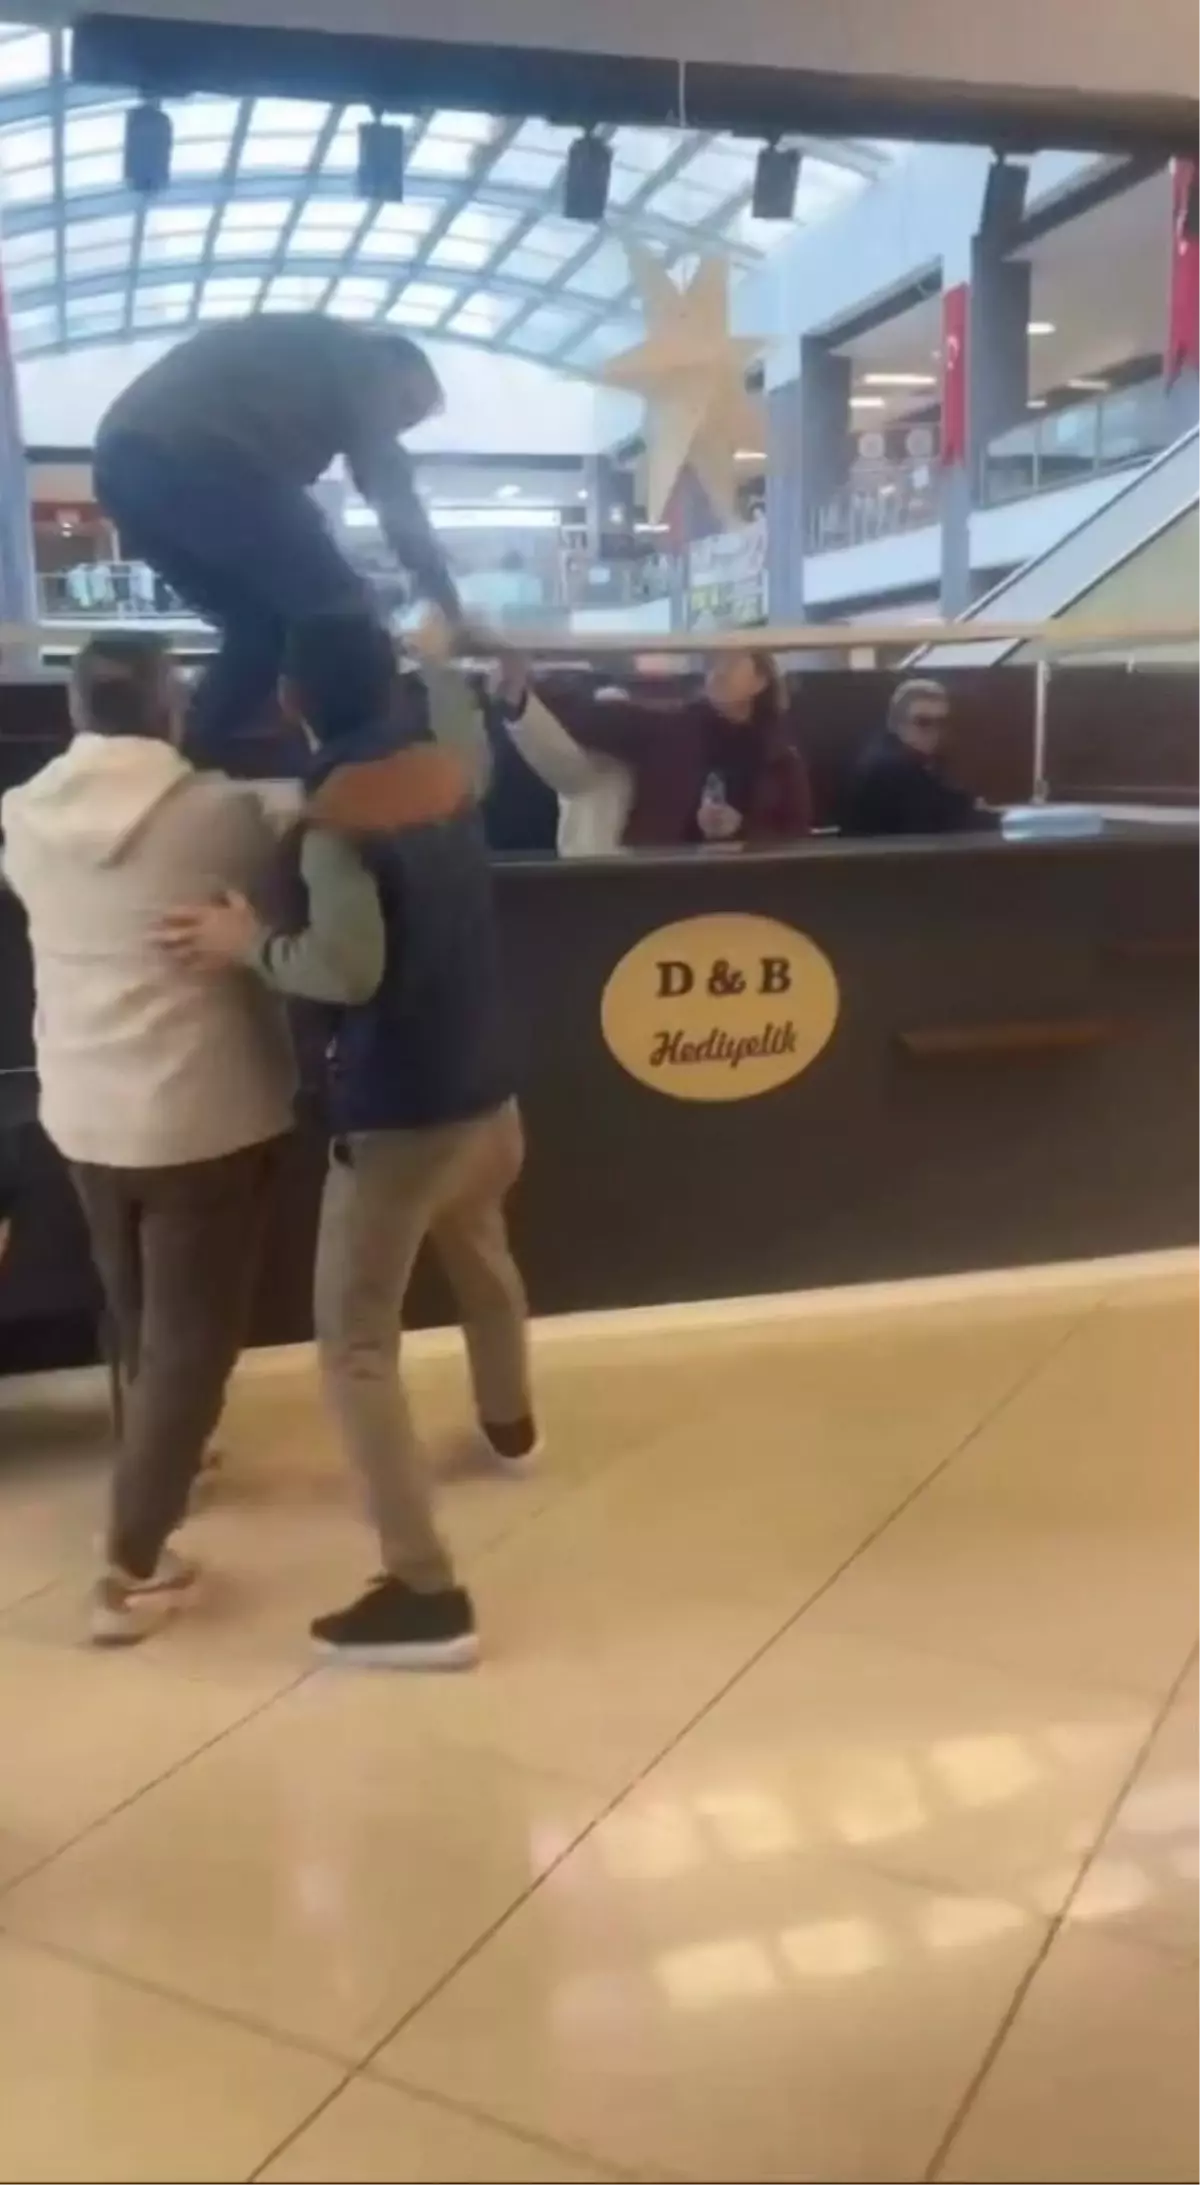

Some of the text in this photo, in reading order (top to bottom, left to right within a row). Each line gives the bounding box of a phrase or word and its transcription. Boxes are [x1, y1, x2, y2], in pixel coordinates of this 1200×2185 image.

[656, 957, 792, 997] D & B
[649, 1020, 797, 1069] Hediyelik
